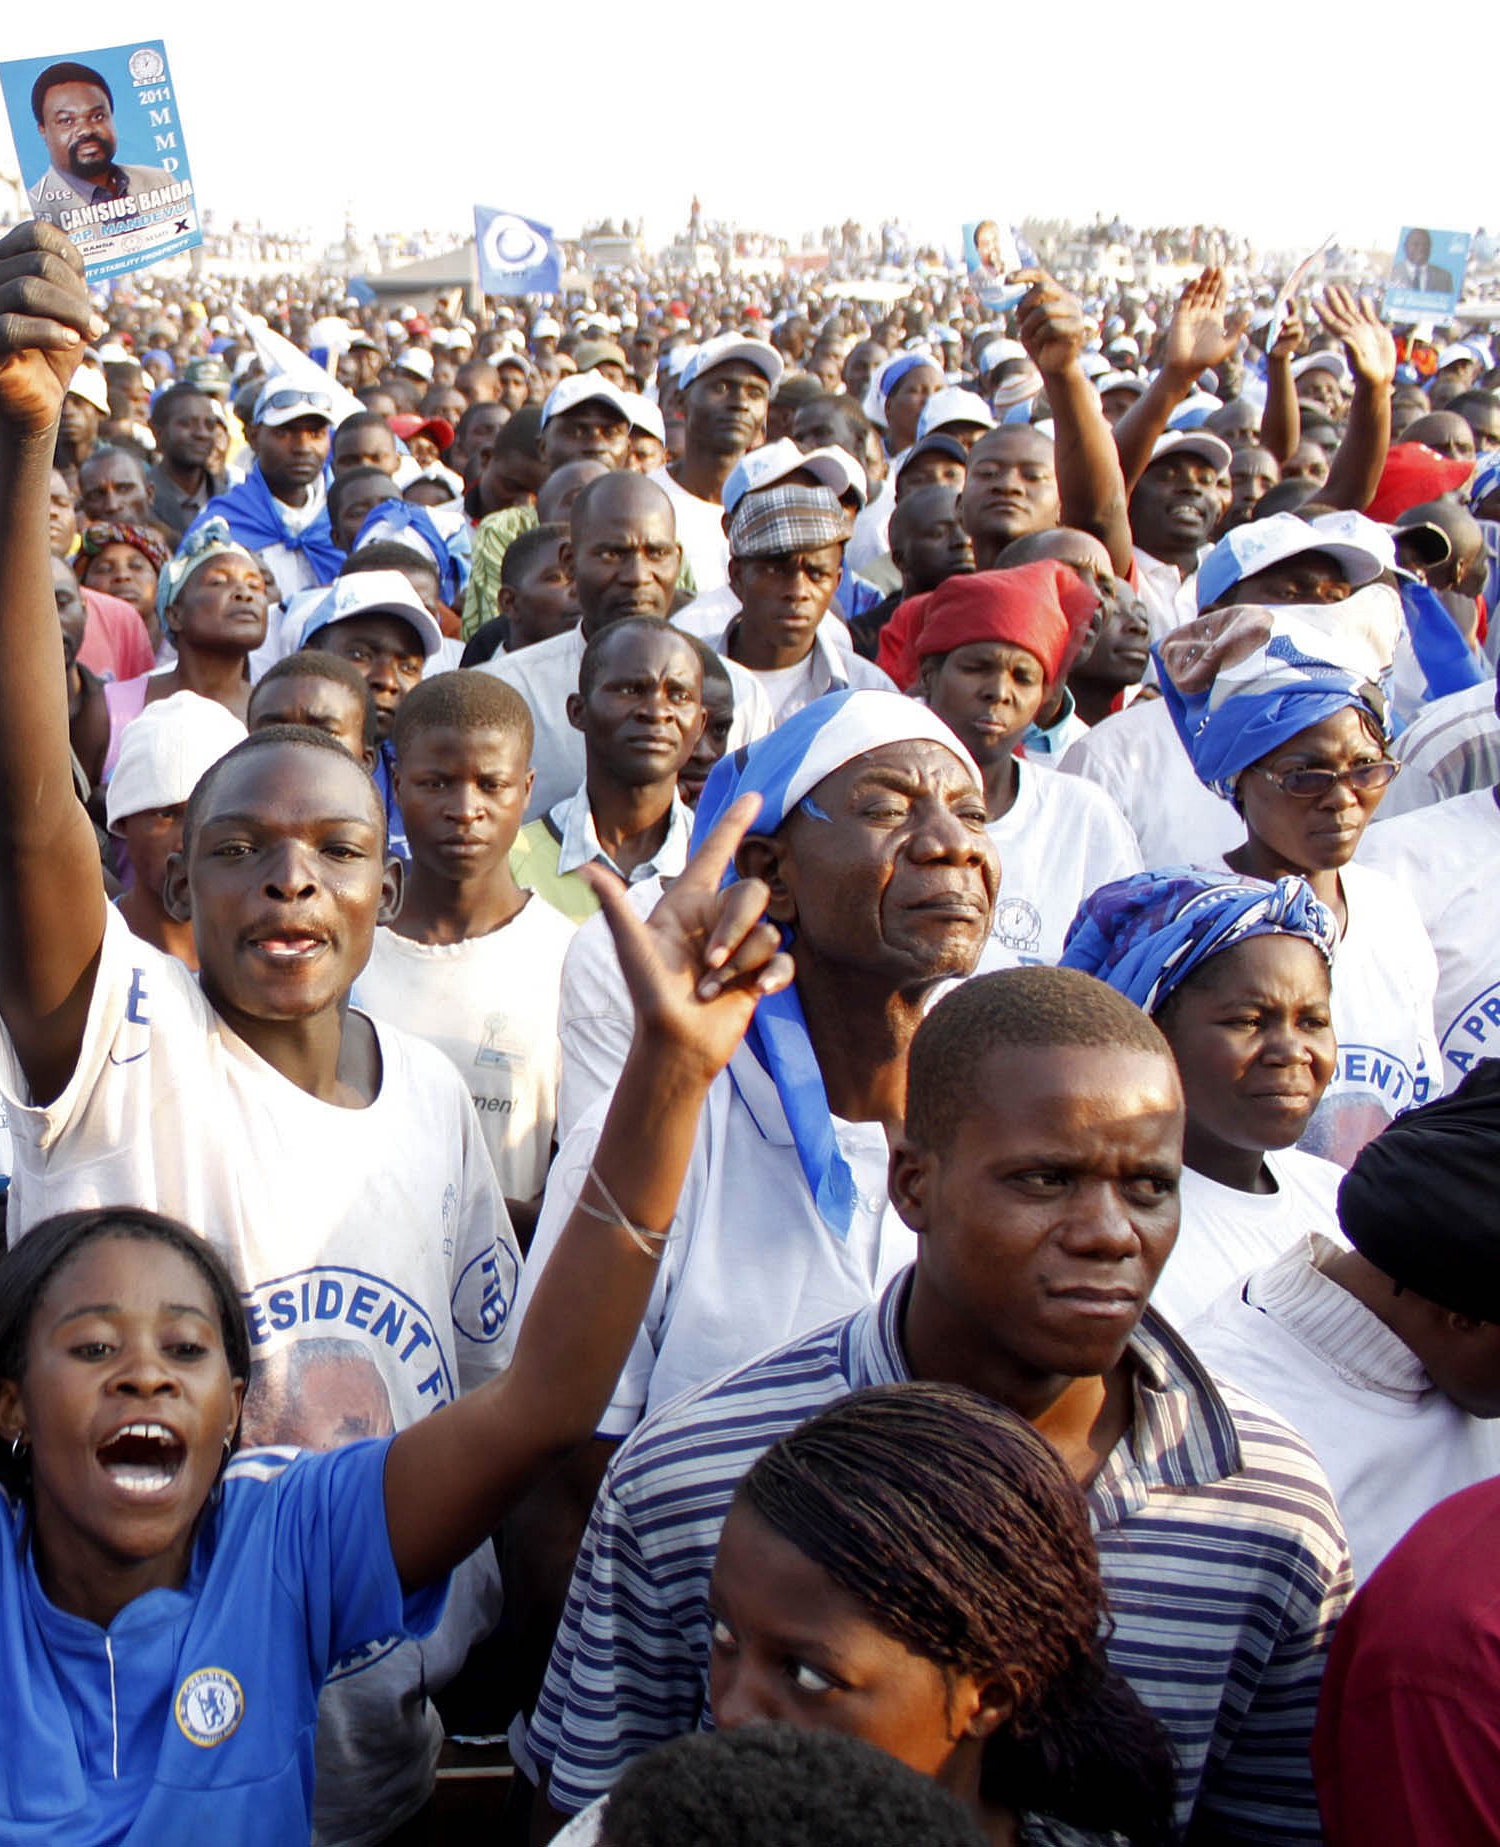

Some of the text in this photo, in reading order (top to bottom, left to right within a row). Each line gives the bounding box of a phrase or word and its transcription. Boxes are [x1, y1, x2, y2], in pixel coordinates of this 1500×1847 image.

[139, 87, 172, 105] 2011
[60, 179, 193, 231] CANISIUS BANDA
[100, 201, 189, 236] MANDEVU
[1334, 1053, 1405, 1100] ENT
